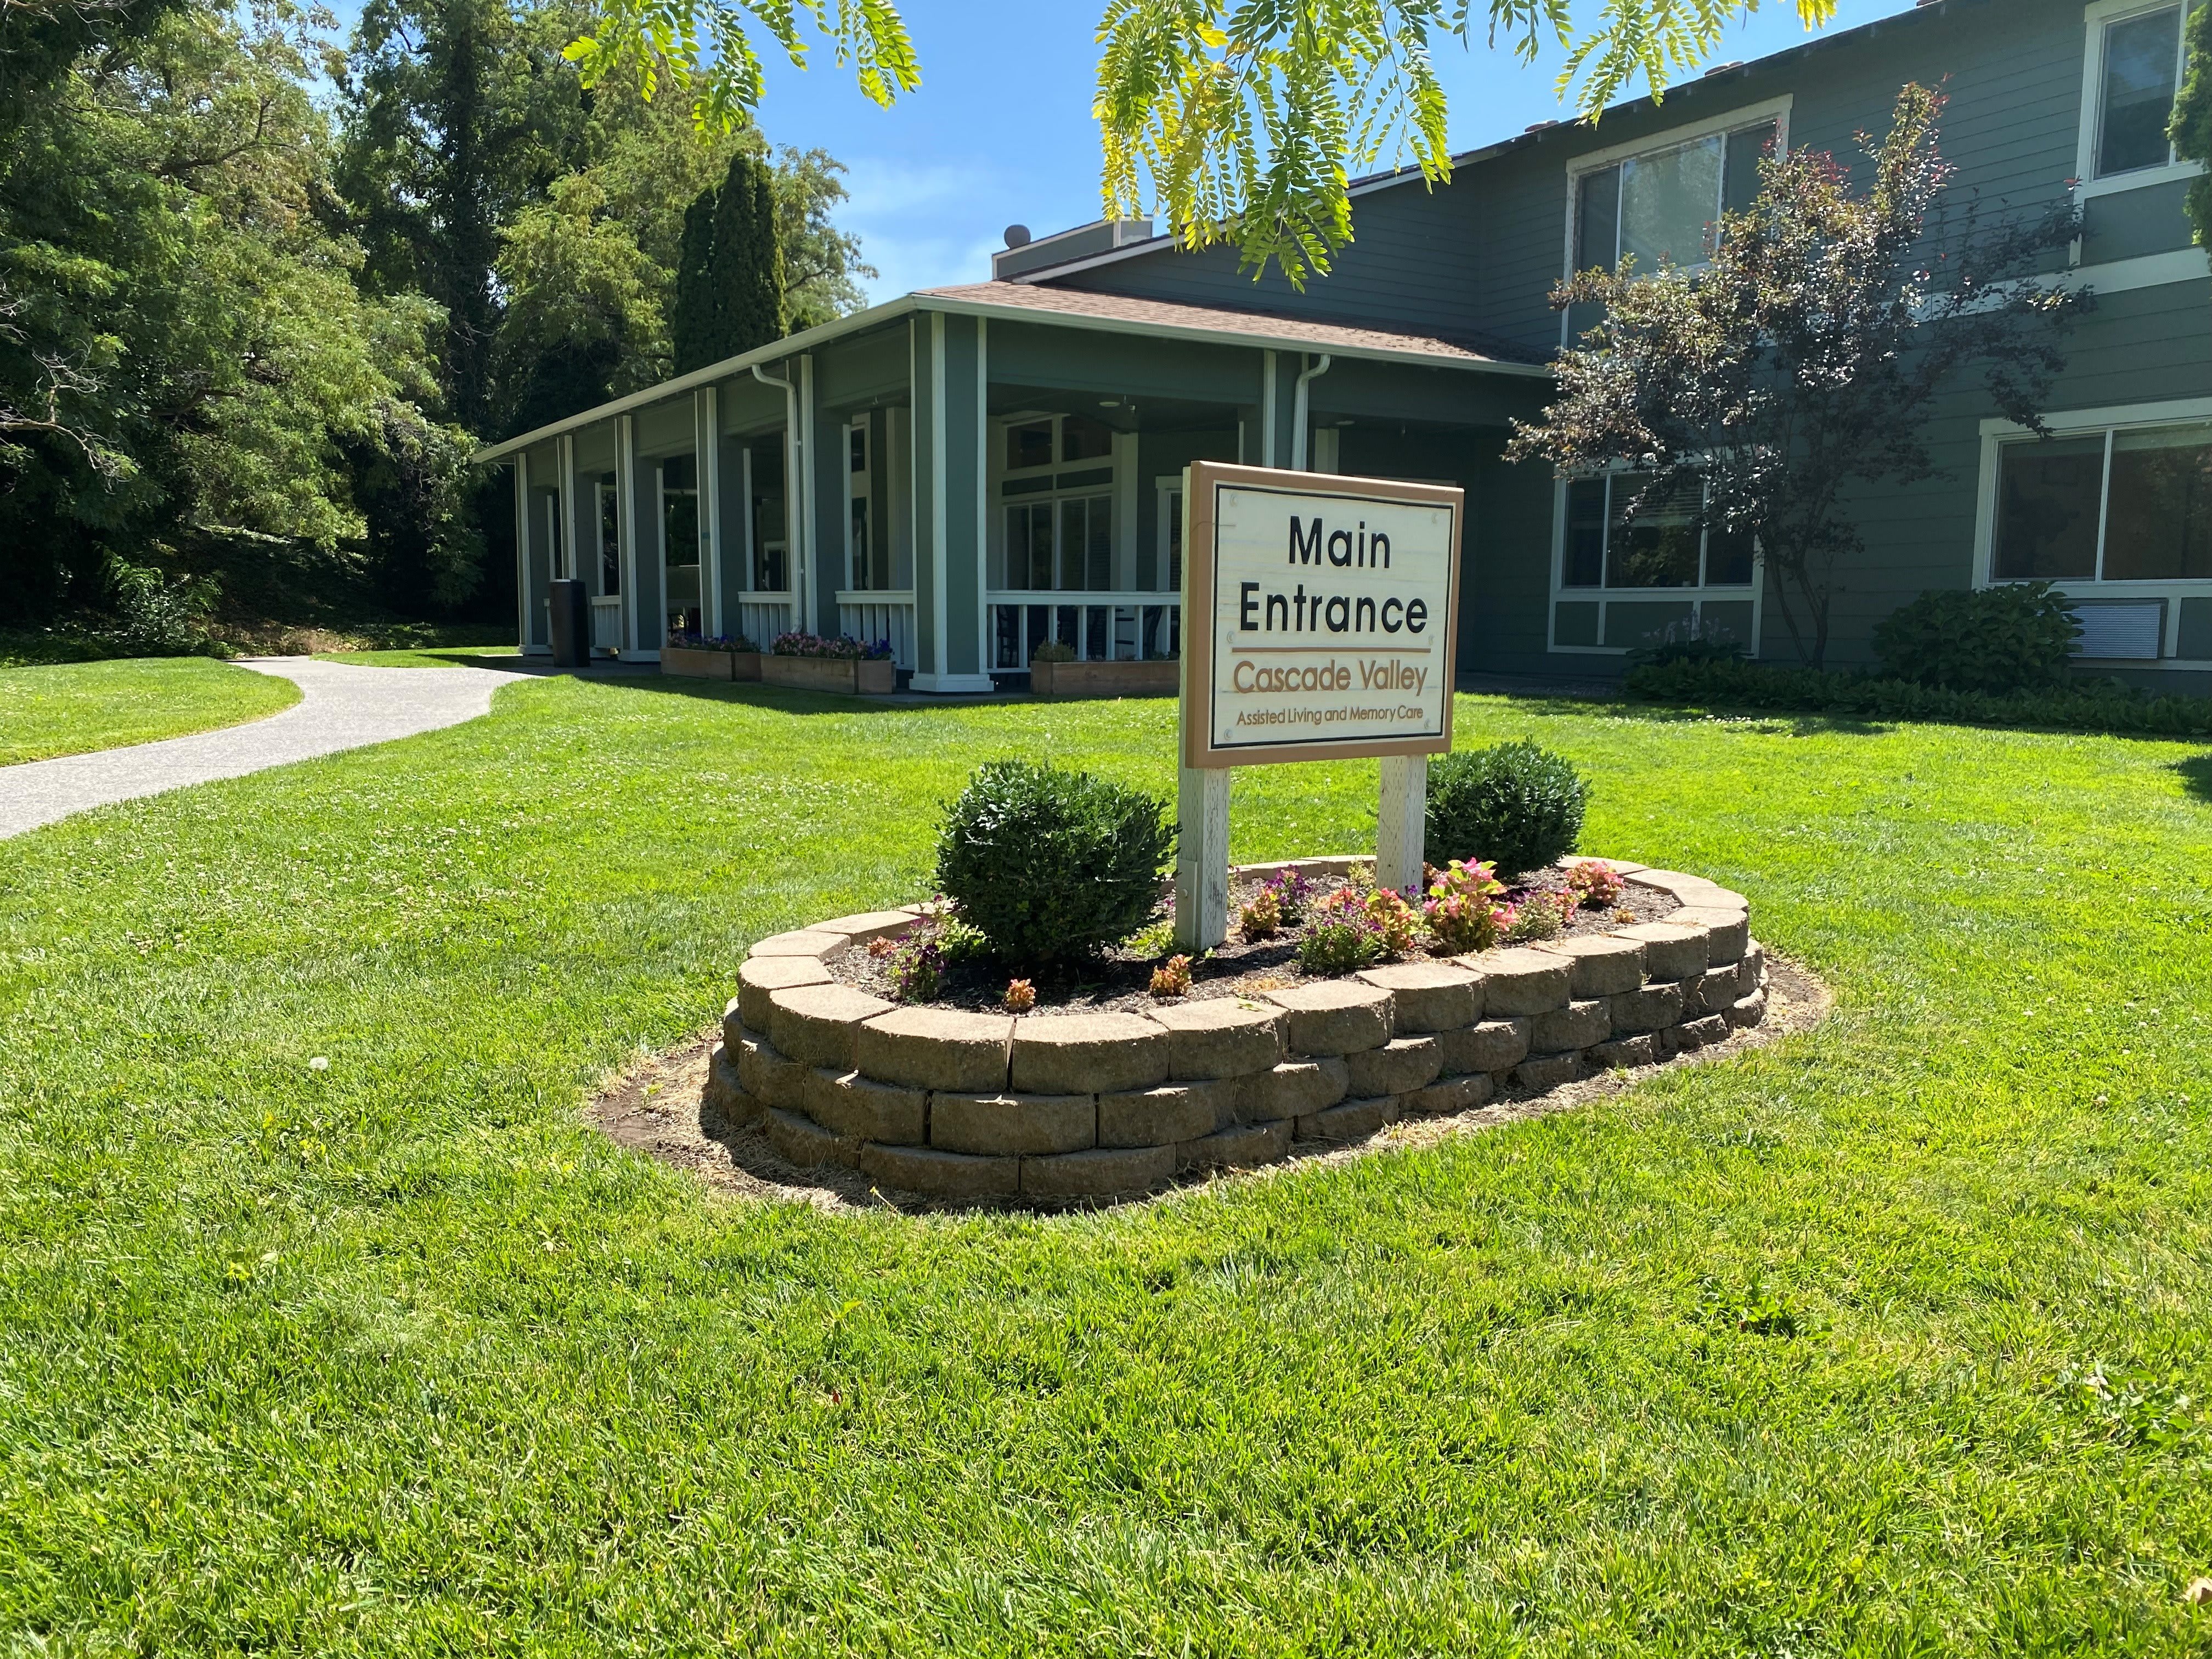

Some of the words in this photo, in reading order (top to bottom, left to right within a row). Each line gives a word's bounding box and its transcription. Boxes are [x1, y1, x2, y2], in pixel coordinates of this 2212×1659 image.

[1289, 515, 1391, 569] Main
[1240, 582, 1428, 634] Entrance
[1233, 659, 1352, 693] Cascade
[1359, 659, 1428, 696] Valley
[1237, 708, 1285, 726] Assisted
[1288, 708, 1322, 725] Living
[1324, 707, 1347, 721] and
[1350, 706, 1396, 722] Memory
[1397, 705, 1424, 719] Care
